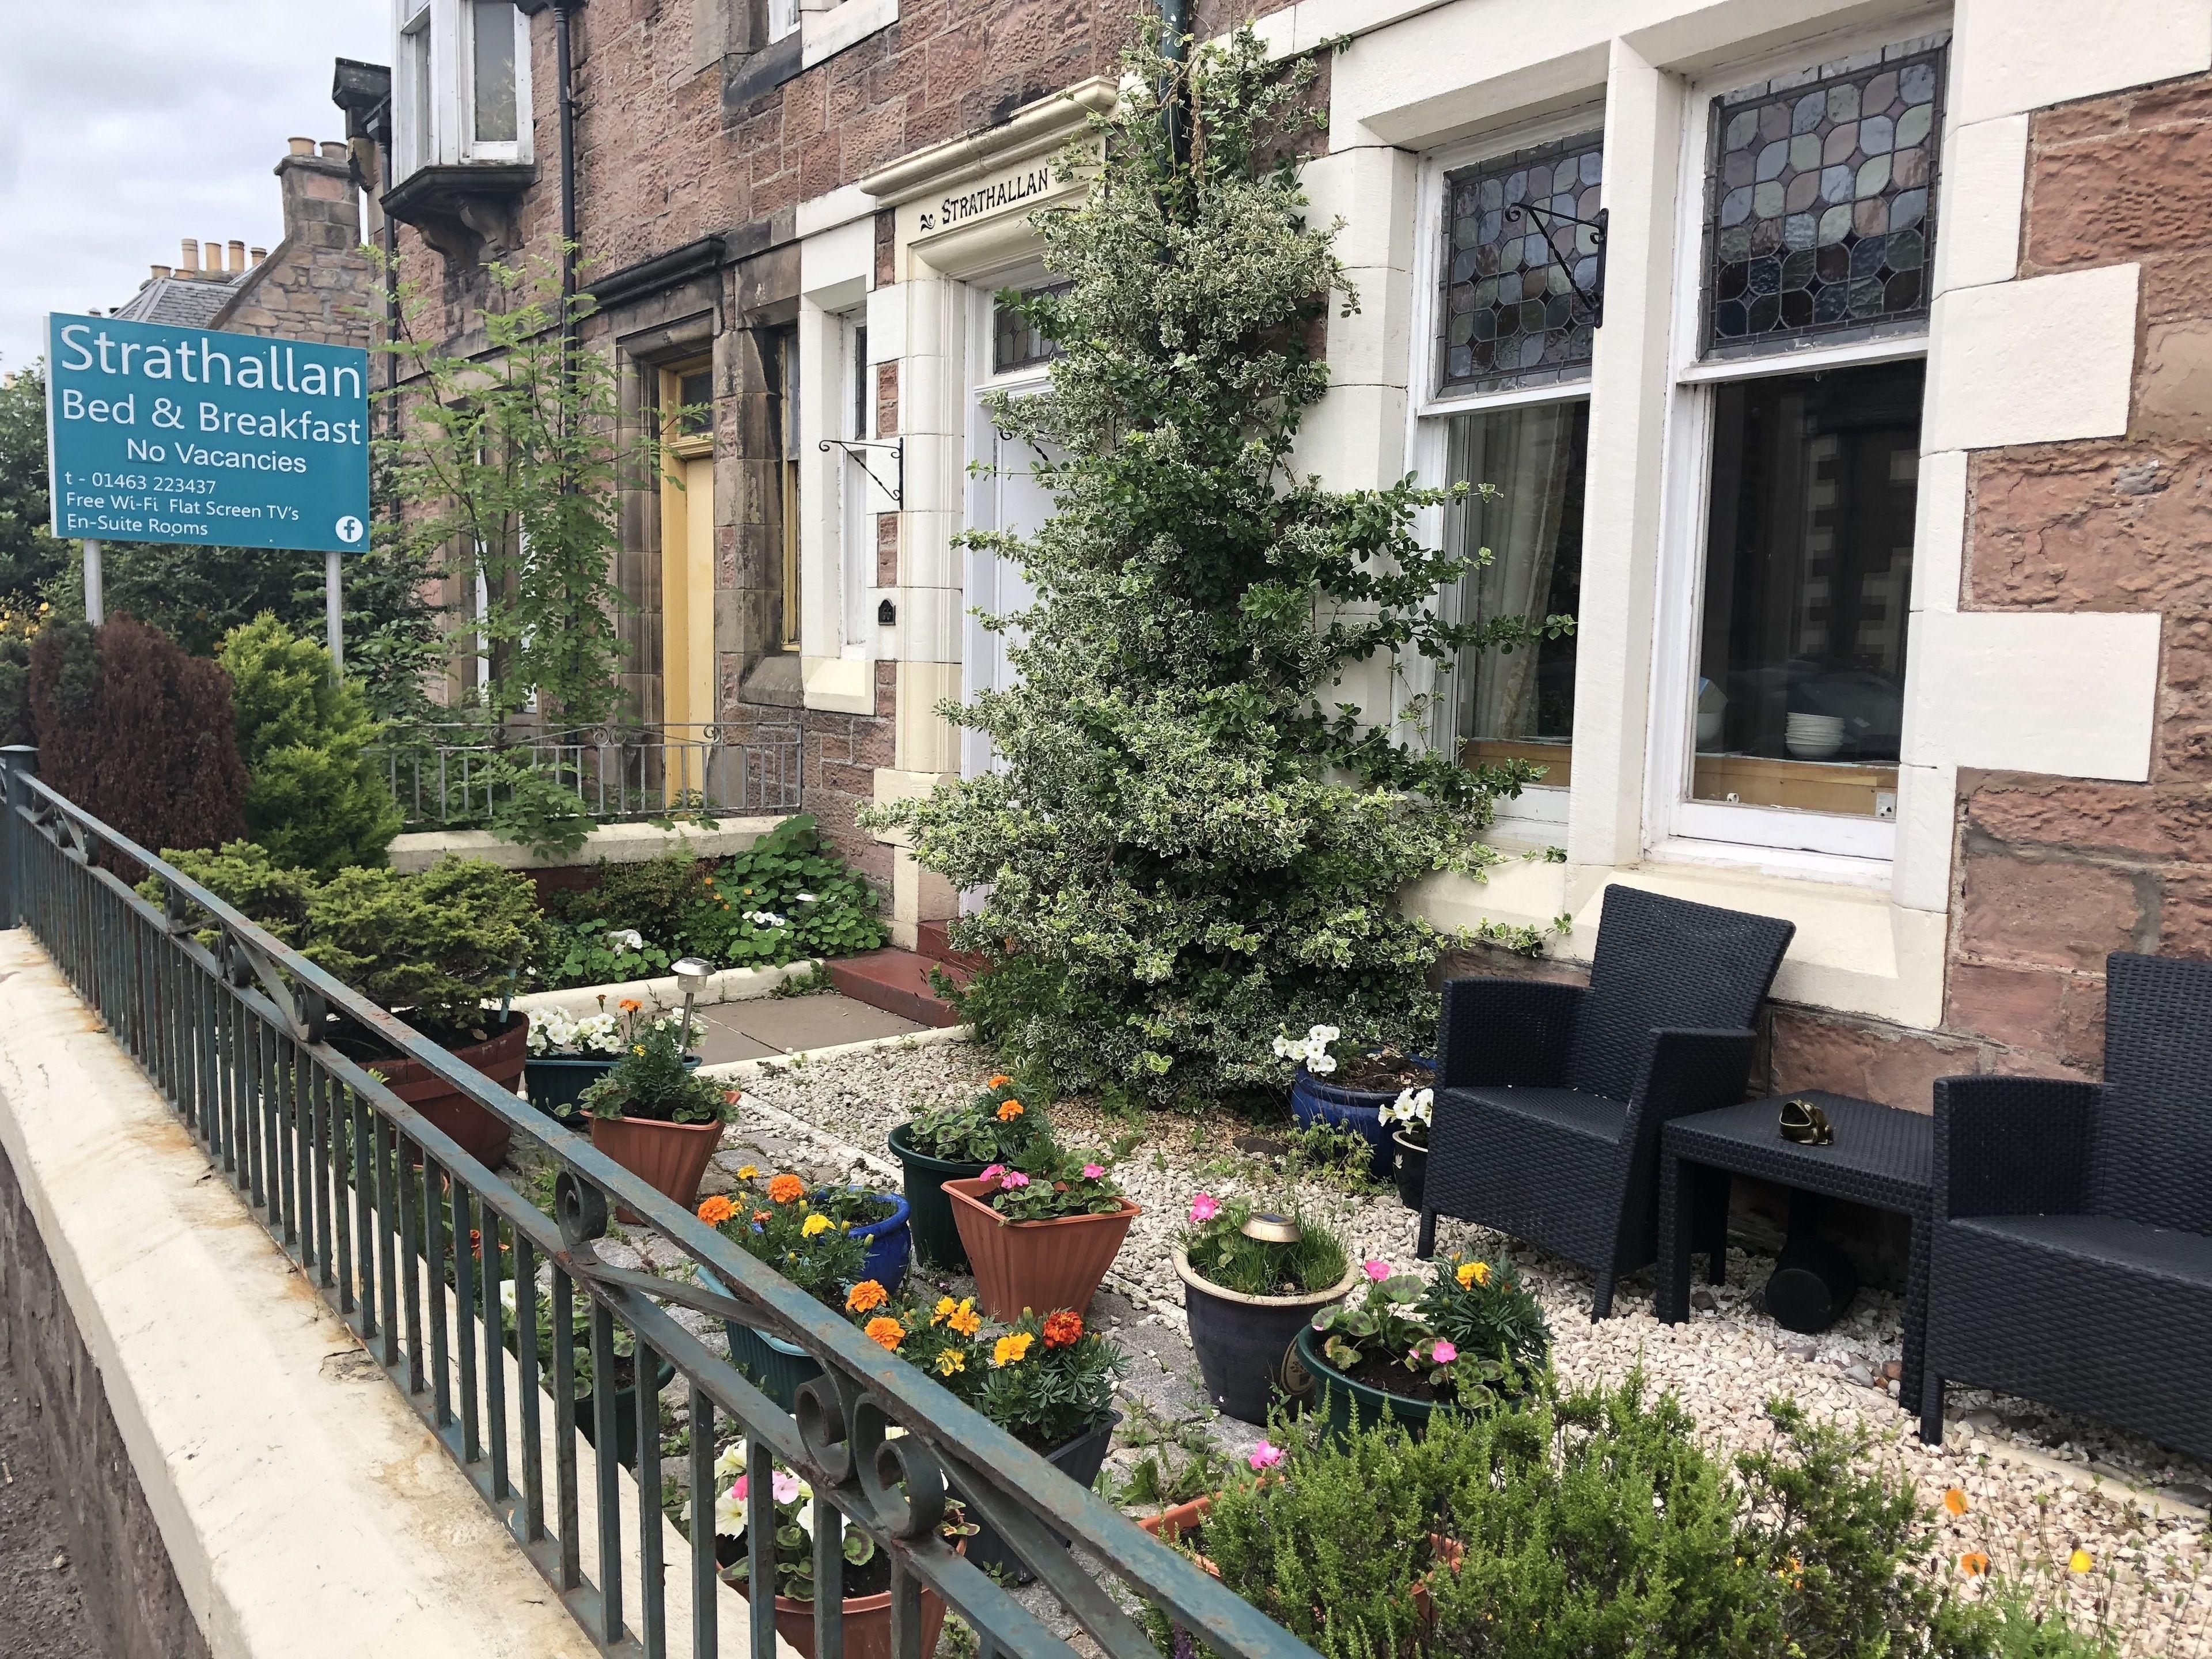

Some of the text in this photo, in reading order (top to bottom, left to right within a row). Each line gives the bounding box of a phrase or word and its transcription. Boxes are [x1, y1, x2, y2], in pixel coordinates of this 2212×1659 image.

[941, 168, 1048, 225] STRATHALLAN
[61, 324, 361, 399] Strathallan
[63, 389, 361, 445] Bed & Breakfast
[127, 438, 307, 474] No Vacancies
[65, 471, 73, 486] t
[92, 471, 147, 491] 01463
[153, 476, 217, 495] 223437
[67, 492, 299, 521] Free Wi-Fi Flat Screen TV's
[67, 514, 209, 536] En-Suite Rooms
